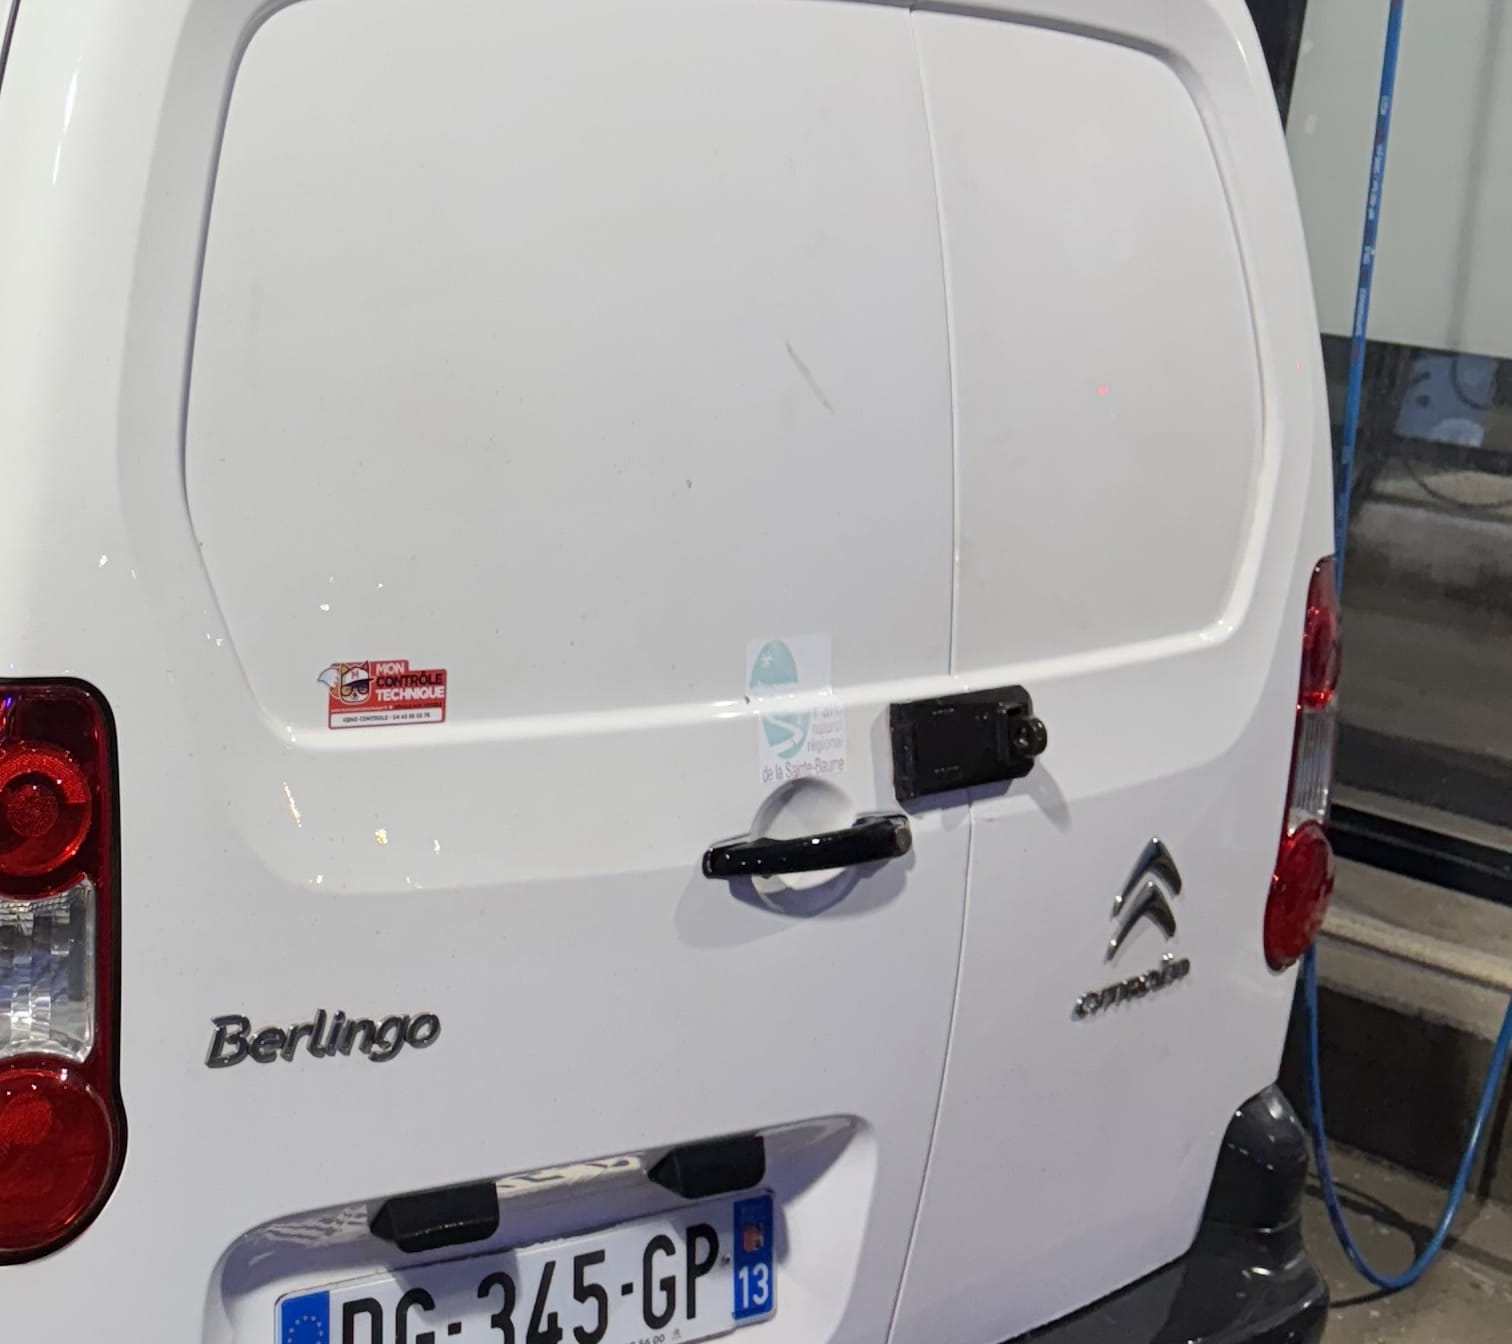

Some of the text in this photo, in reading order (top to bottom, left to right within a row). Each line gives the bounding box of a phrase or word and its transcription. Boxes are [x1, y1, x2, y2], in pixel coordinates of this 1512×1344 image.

[376, 662, 405, 675] MON
[375, 670, 442, 687] CONTRÔLE
[375, 686, 445, 702] TECHNIQUE
[204, 1009, 441, 1069] Berlingo
[738, 1262, 768, 1309] 13
[653, 1334, 665, 1344] 00
